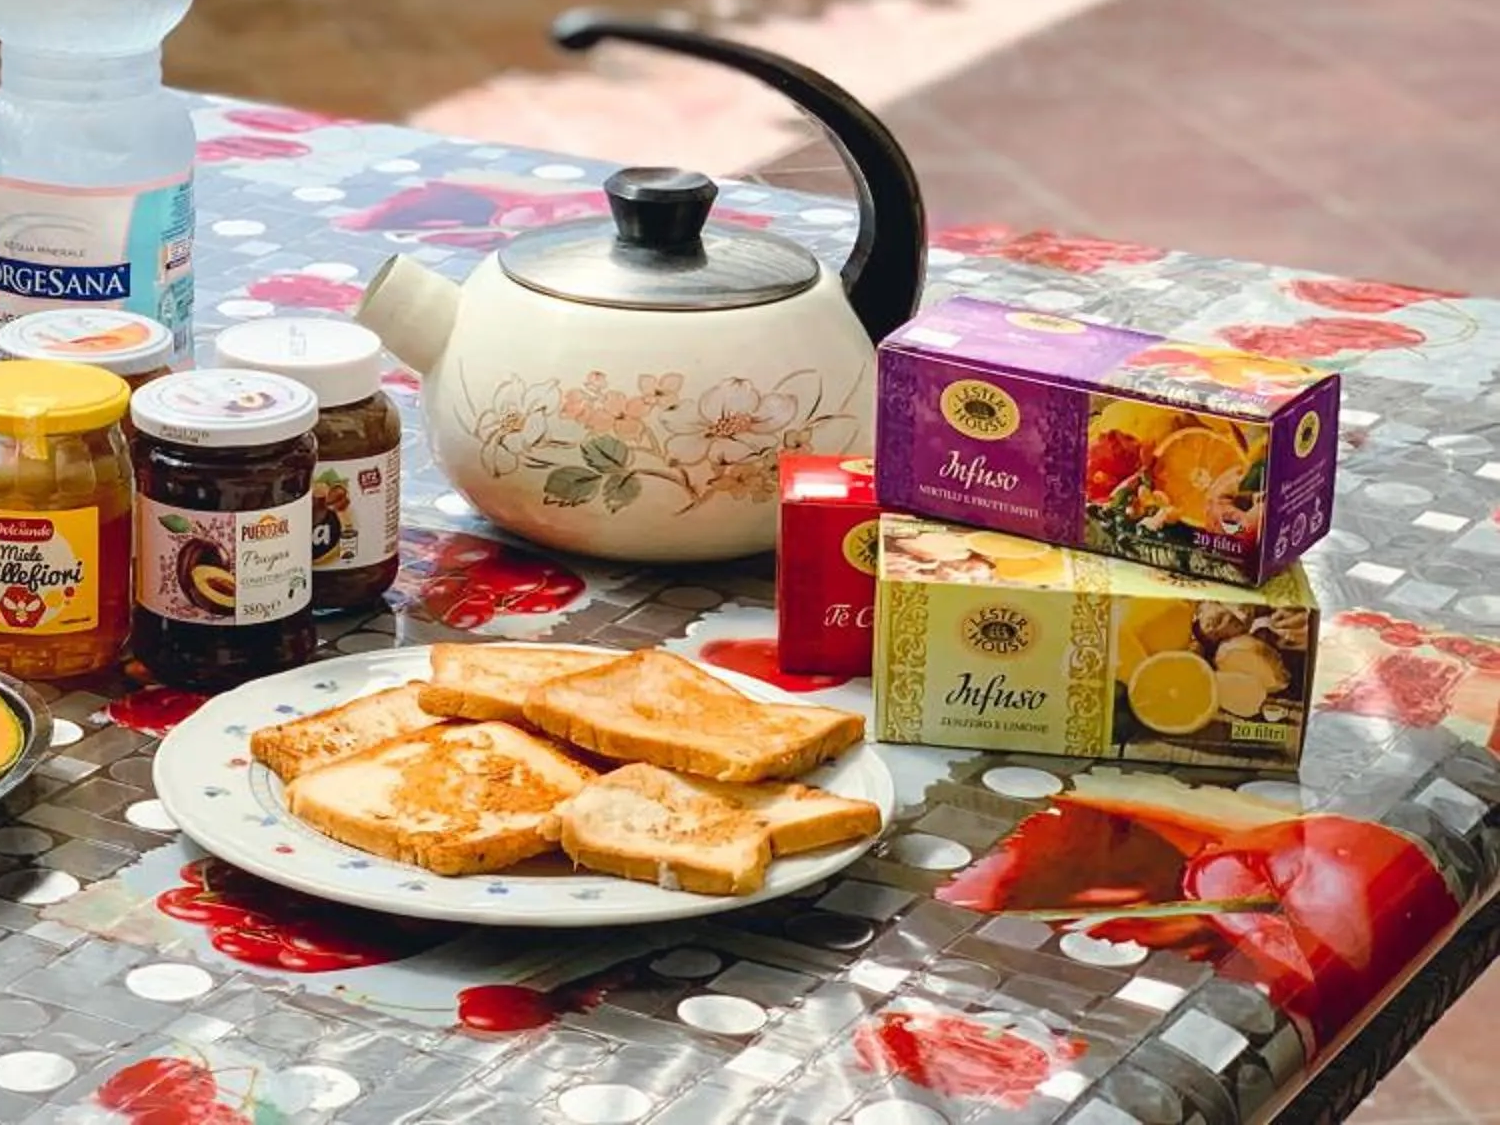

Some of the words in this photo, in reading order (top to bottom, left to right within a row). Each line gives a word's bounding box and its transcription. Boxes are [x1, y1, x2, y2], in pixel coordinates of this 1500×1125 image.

[954, 386, 1007, 411] LESTER
[956, 406, 1009, 435] HOUSE
[939, 450, 1020, 490] Infuso
[1192, 531, 1209, 546] 20
[1212, 532, 1243, 555] filtri
[971, 606, 1029, 630] LESTER
[969, 631, 1030, 654] HOUSE
[944, 672, 1049, 716] Infuso
[1232, 725, 1251, 738] 20
[1253, 724, 1286, 740] filtri
